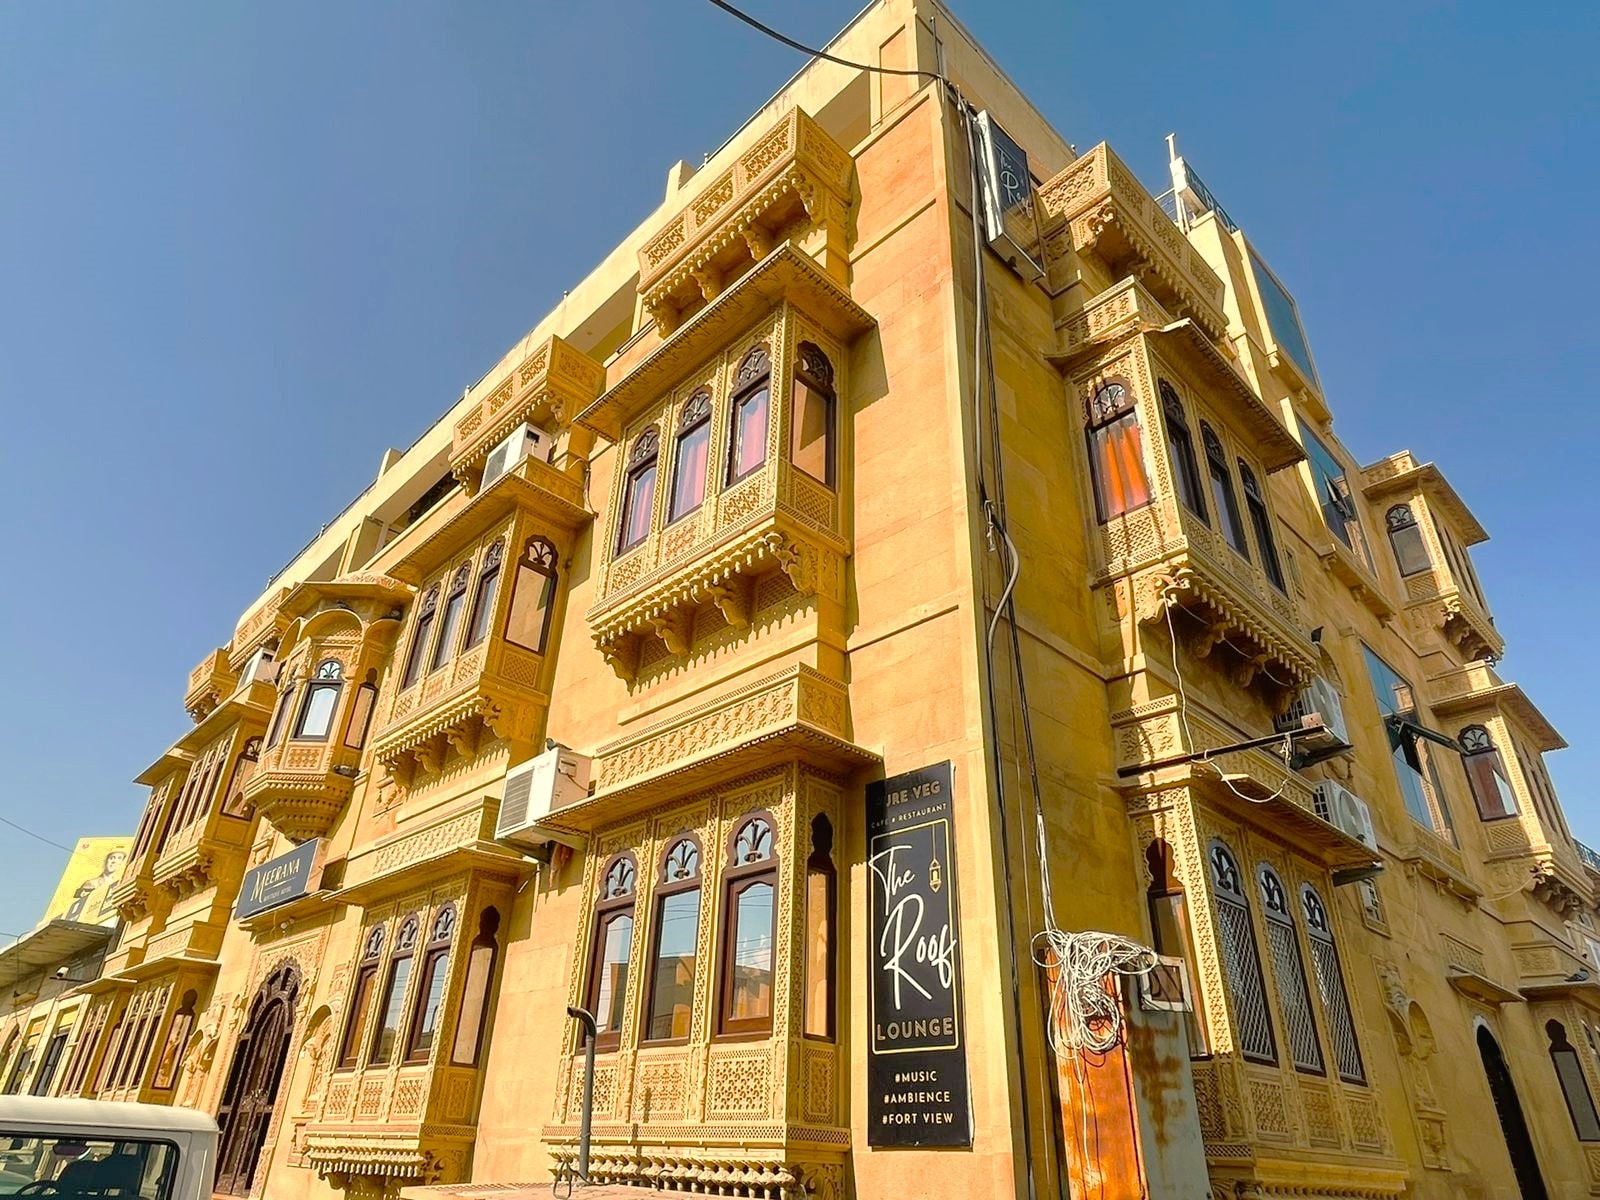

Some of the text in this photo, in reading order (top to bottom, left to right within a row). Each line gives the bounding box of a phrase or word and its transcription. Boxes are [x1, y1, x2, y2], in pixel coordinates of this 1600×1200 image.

[912, 780, 941, 799] VEG
[898, 803, 947, 822] RESTAURANT
[249, 858, 301, 904] MEERANA
[868, 845, 916, 916] The
[880, 893, 958, 1011] Roof
[876, 1017, 954, 1041] LOUNGE
[895, 1070, 938, 1083] #MUSIC
[883, 1091, 951, 1104] #AMBIENCE
[882, 1112, 954, 1125] #FORT VIEW
